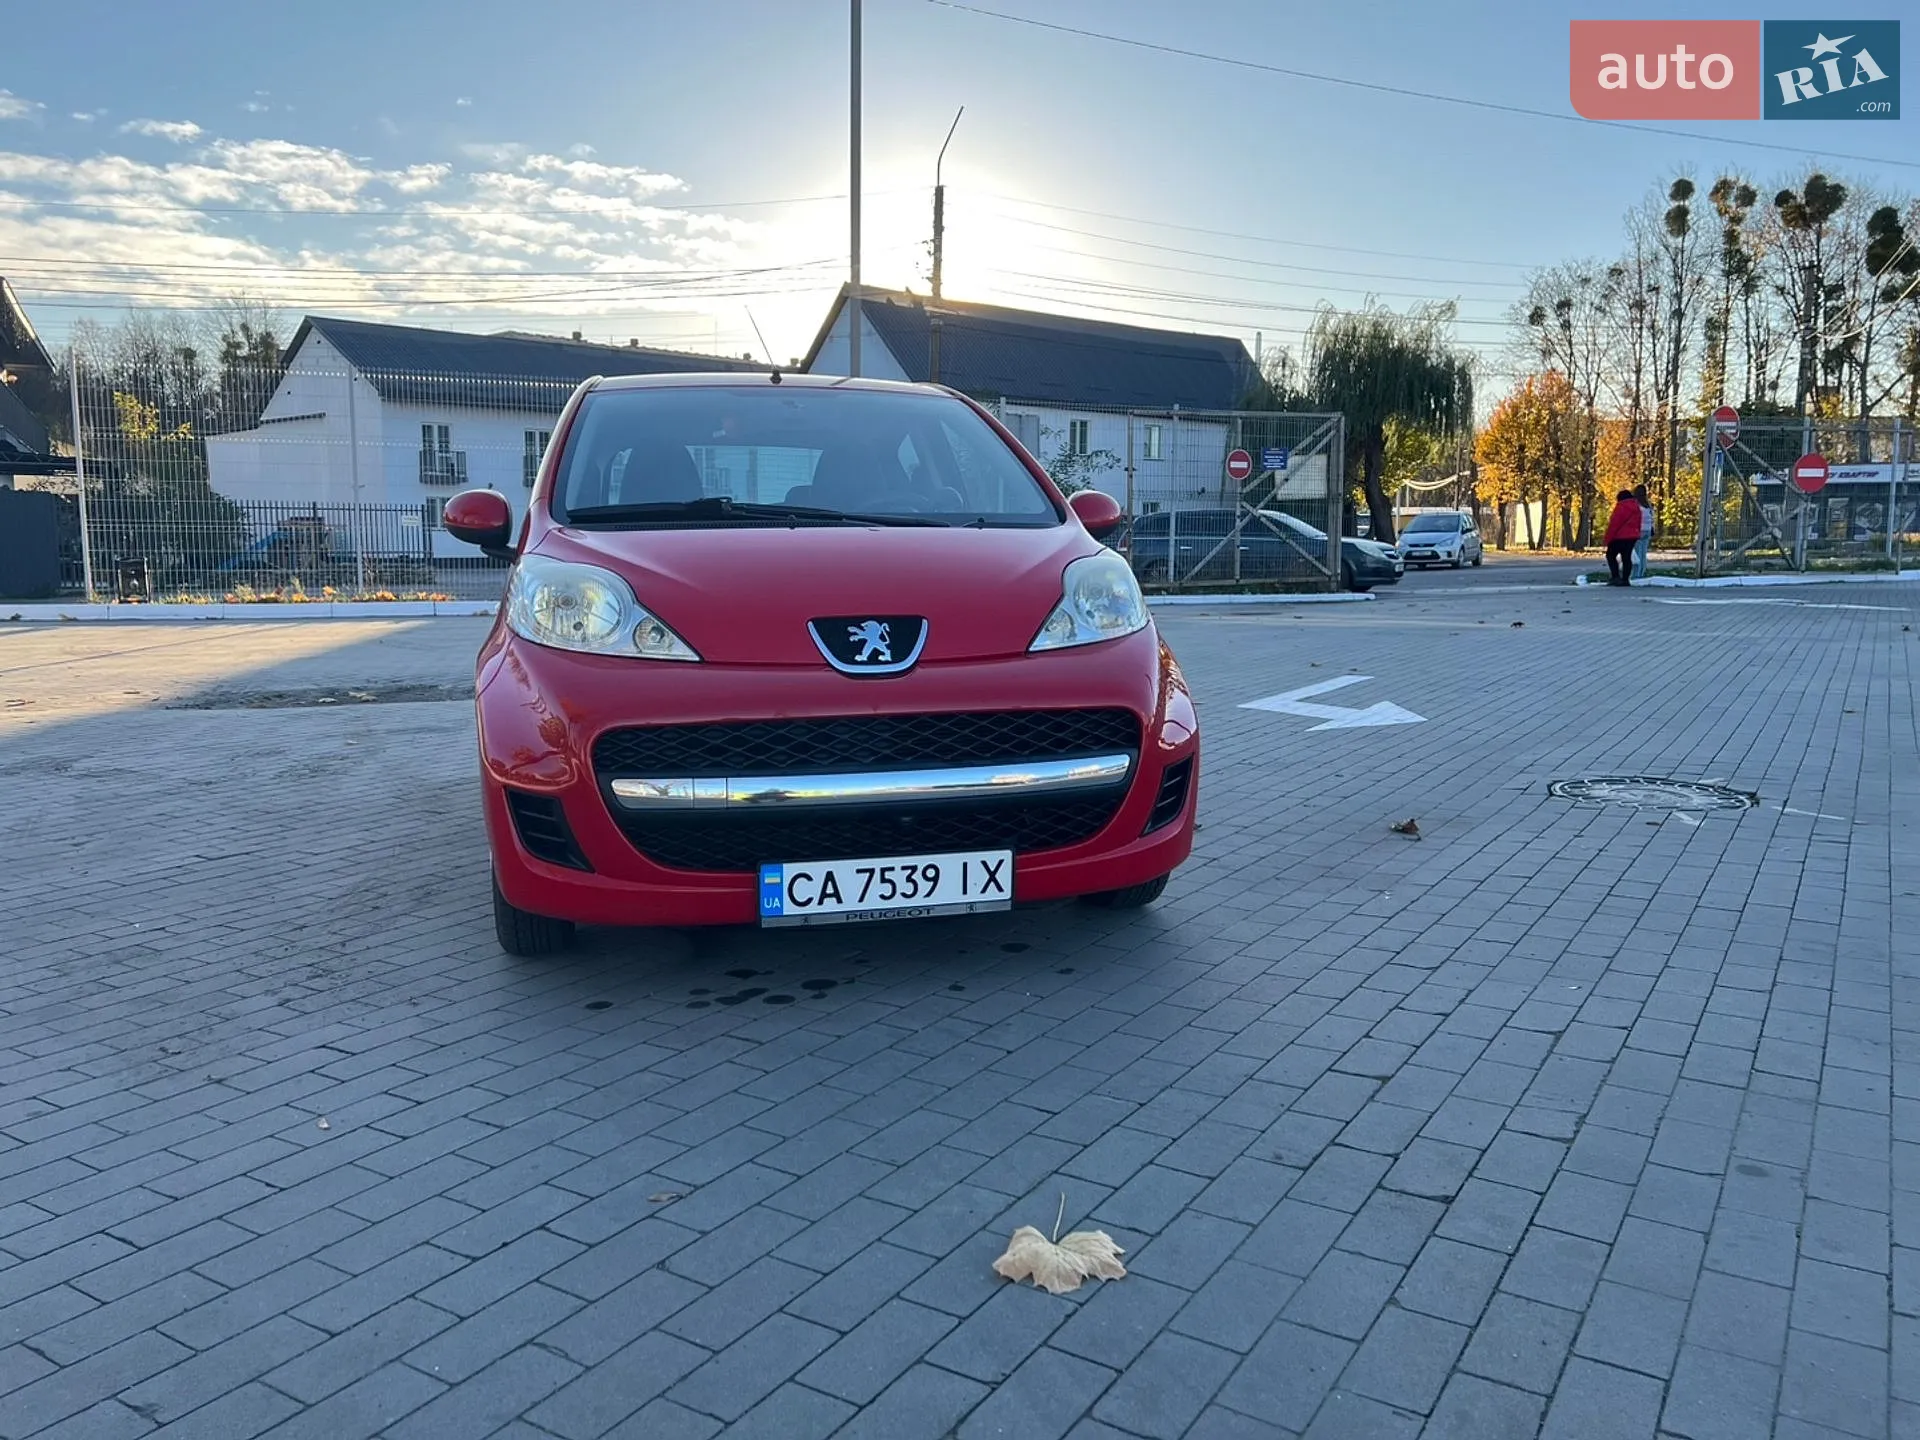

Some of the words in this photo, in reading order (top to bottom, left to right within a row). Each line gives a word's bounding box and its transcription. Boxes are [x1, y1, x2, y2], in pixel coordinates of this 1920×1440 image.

[787, 869, 843, 907] CA
[854, 863, 941, 903] 7539
[960, 858, 1006, 895] IX
[763, 897, 782, 910] UA
[845, 908, 935, 922] PEUGEOT
